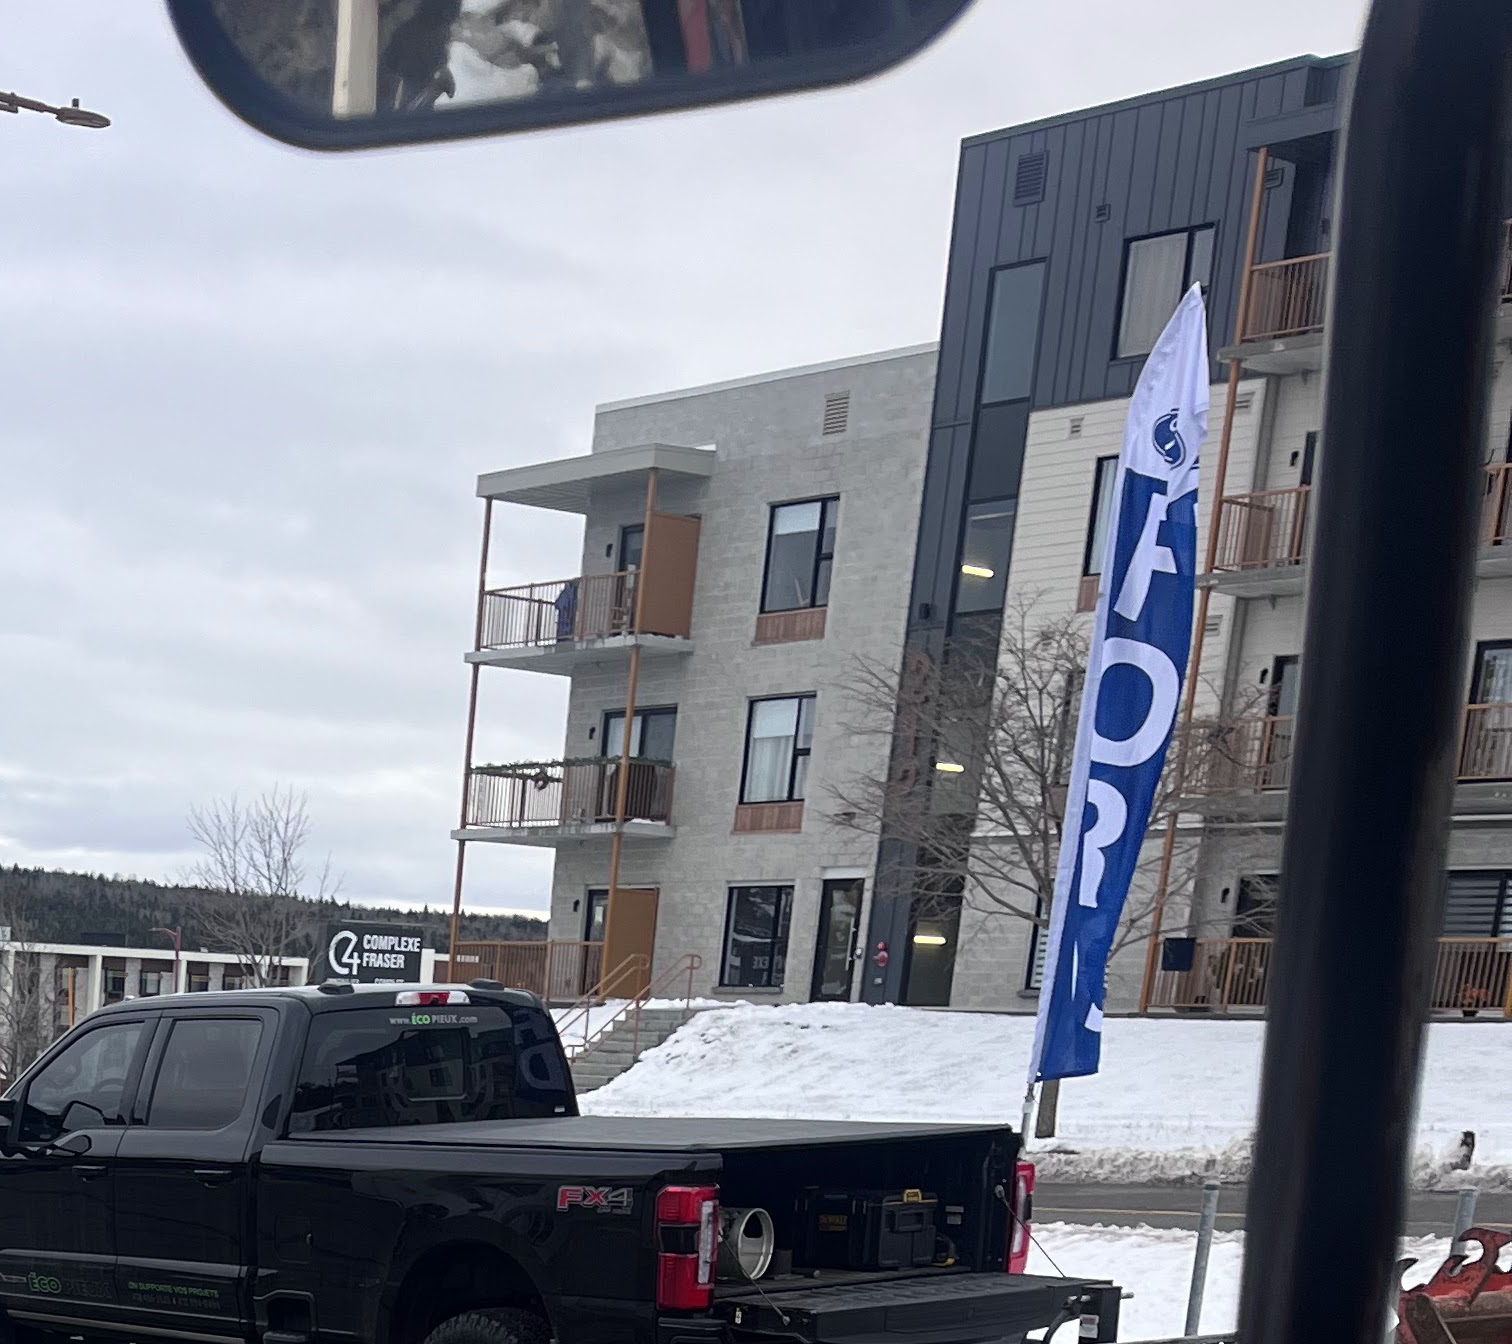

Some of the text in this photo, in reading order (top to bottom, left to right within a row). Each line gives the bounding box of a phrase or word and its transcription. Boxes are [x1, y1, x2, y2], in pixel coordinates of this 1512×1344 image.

[1070, 490, 1199, 1034] FOR
[363, 934, 422, 953] COMPLEXE
[362, 951, 406, 969] FRASER
[556, 1184, 634, 1213] FX4
